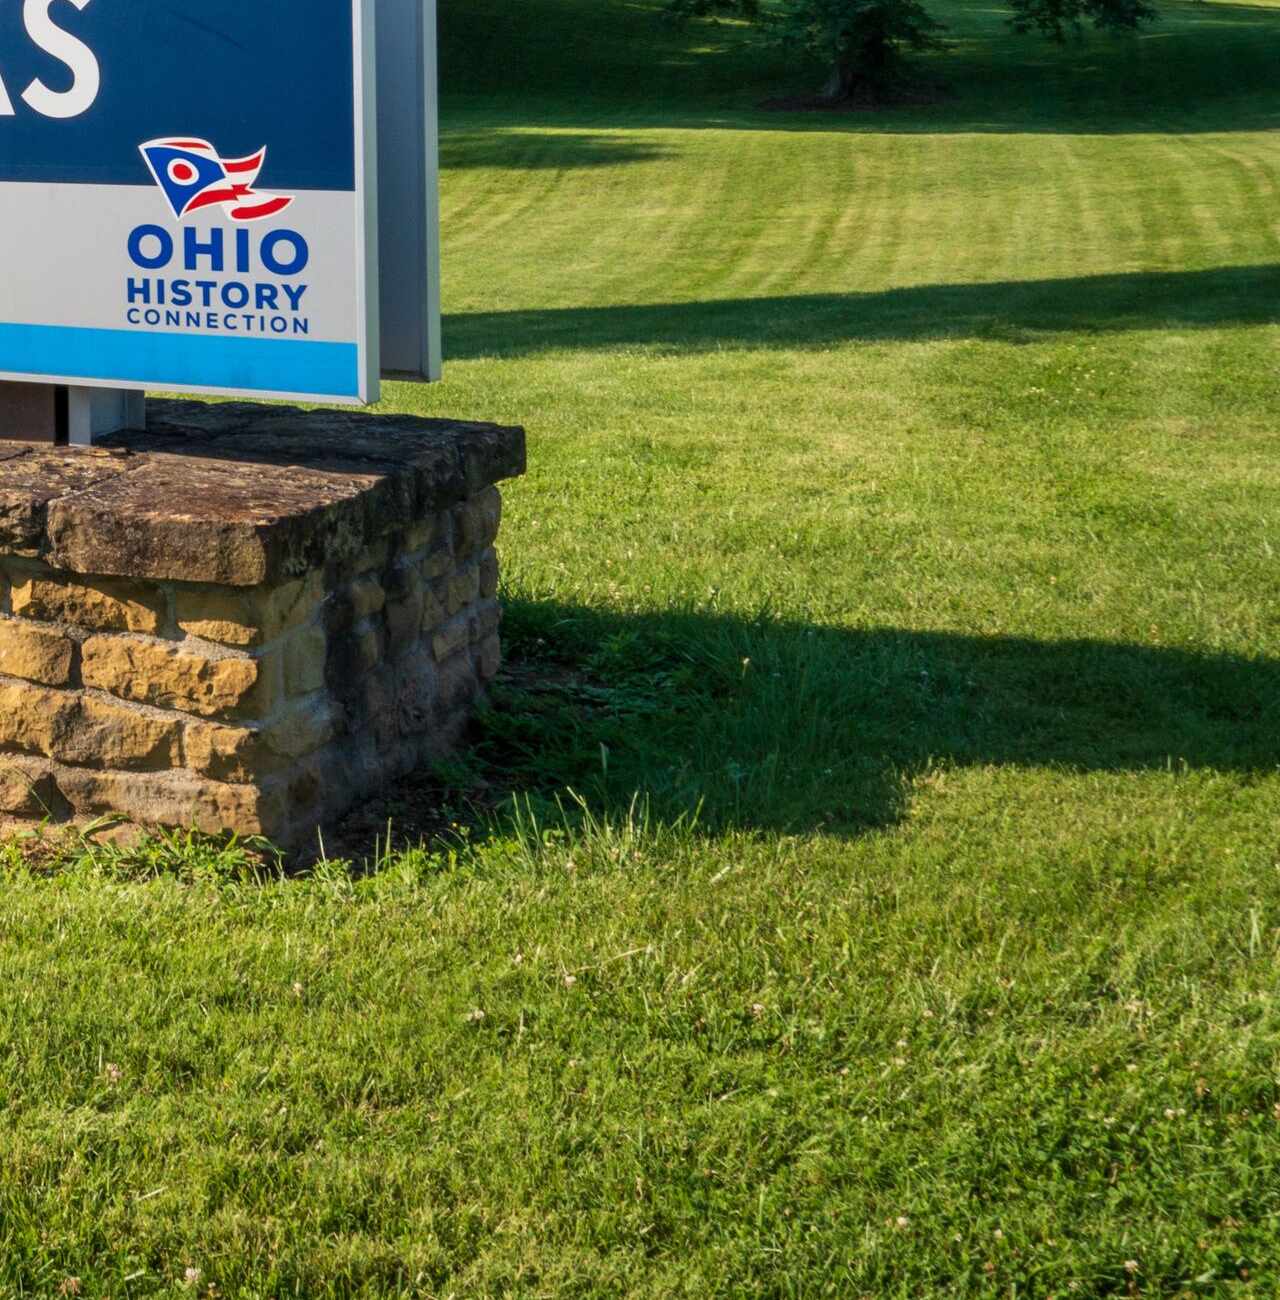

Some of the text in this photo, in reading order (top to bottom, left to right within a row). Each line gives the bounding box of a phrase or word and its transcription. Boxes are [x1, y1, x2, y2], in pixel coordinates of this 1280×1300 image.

[127, 224, 309, 276] OHIO
[127, 277, 307, 311] HISTORY
[127, 308, 308, 334] CONNECTION
